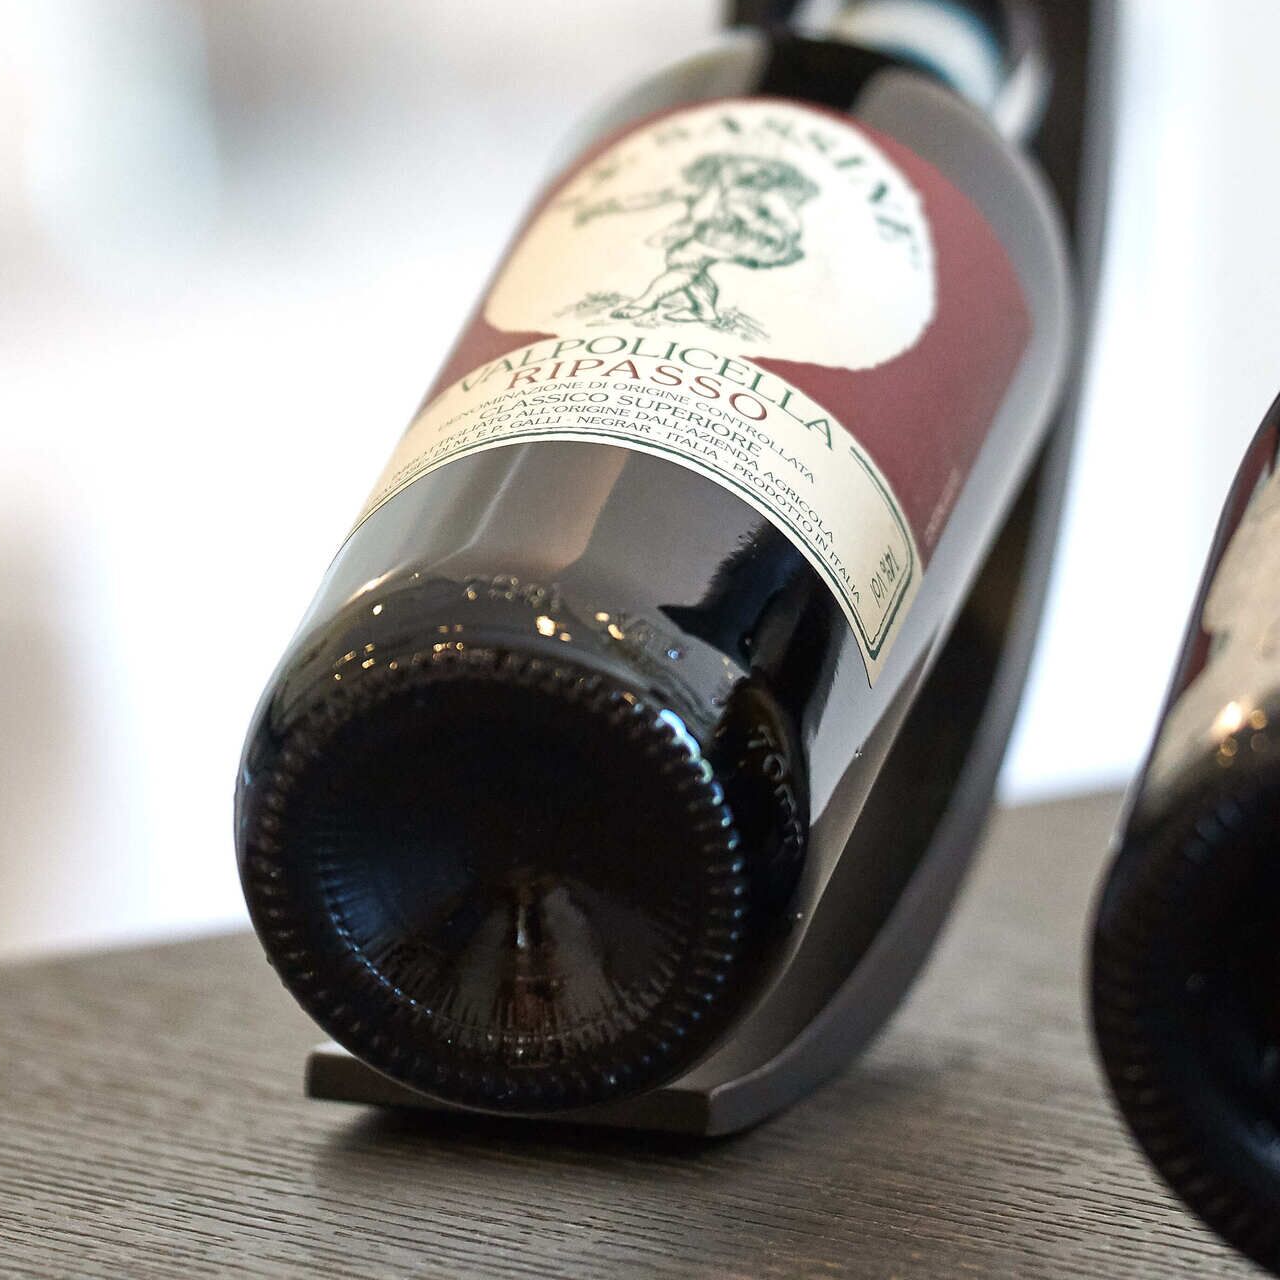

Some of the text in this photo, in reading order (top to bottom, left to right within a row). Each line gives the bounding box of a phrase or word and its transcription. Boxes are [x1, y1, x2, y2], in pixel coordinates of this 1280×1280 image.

[461, 335, 833, 451] VALPOLICELLA
[479, 392, 762, 458] CLASSICO SUPERIORE
[506, 358, 768, 422] RIPASSO
[588, 381, 608, 389] DI
[613, 382, 690, 406] ORIGINE
[695, 401, 815, 485] CONTROLLATA
[509, 416, 562, 429] GALLI
[576, 416, 651, 434] NEGRAR
[665, 431, 718, 461] ITALIA
[732, 463, 813, 533] PRODOTTO
[814, 533, 829, 552] IN
[824, 551, 861, 606] ITALIA
[516, 405, 630, 420] ALL'ORIGINE
[635, 411, 759, 471] DALL'AZIENDA
[763, 471, 834, 544] AGRICOLA
